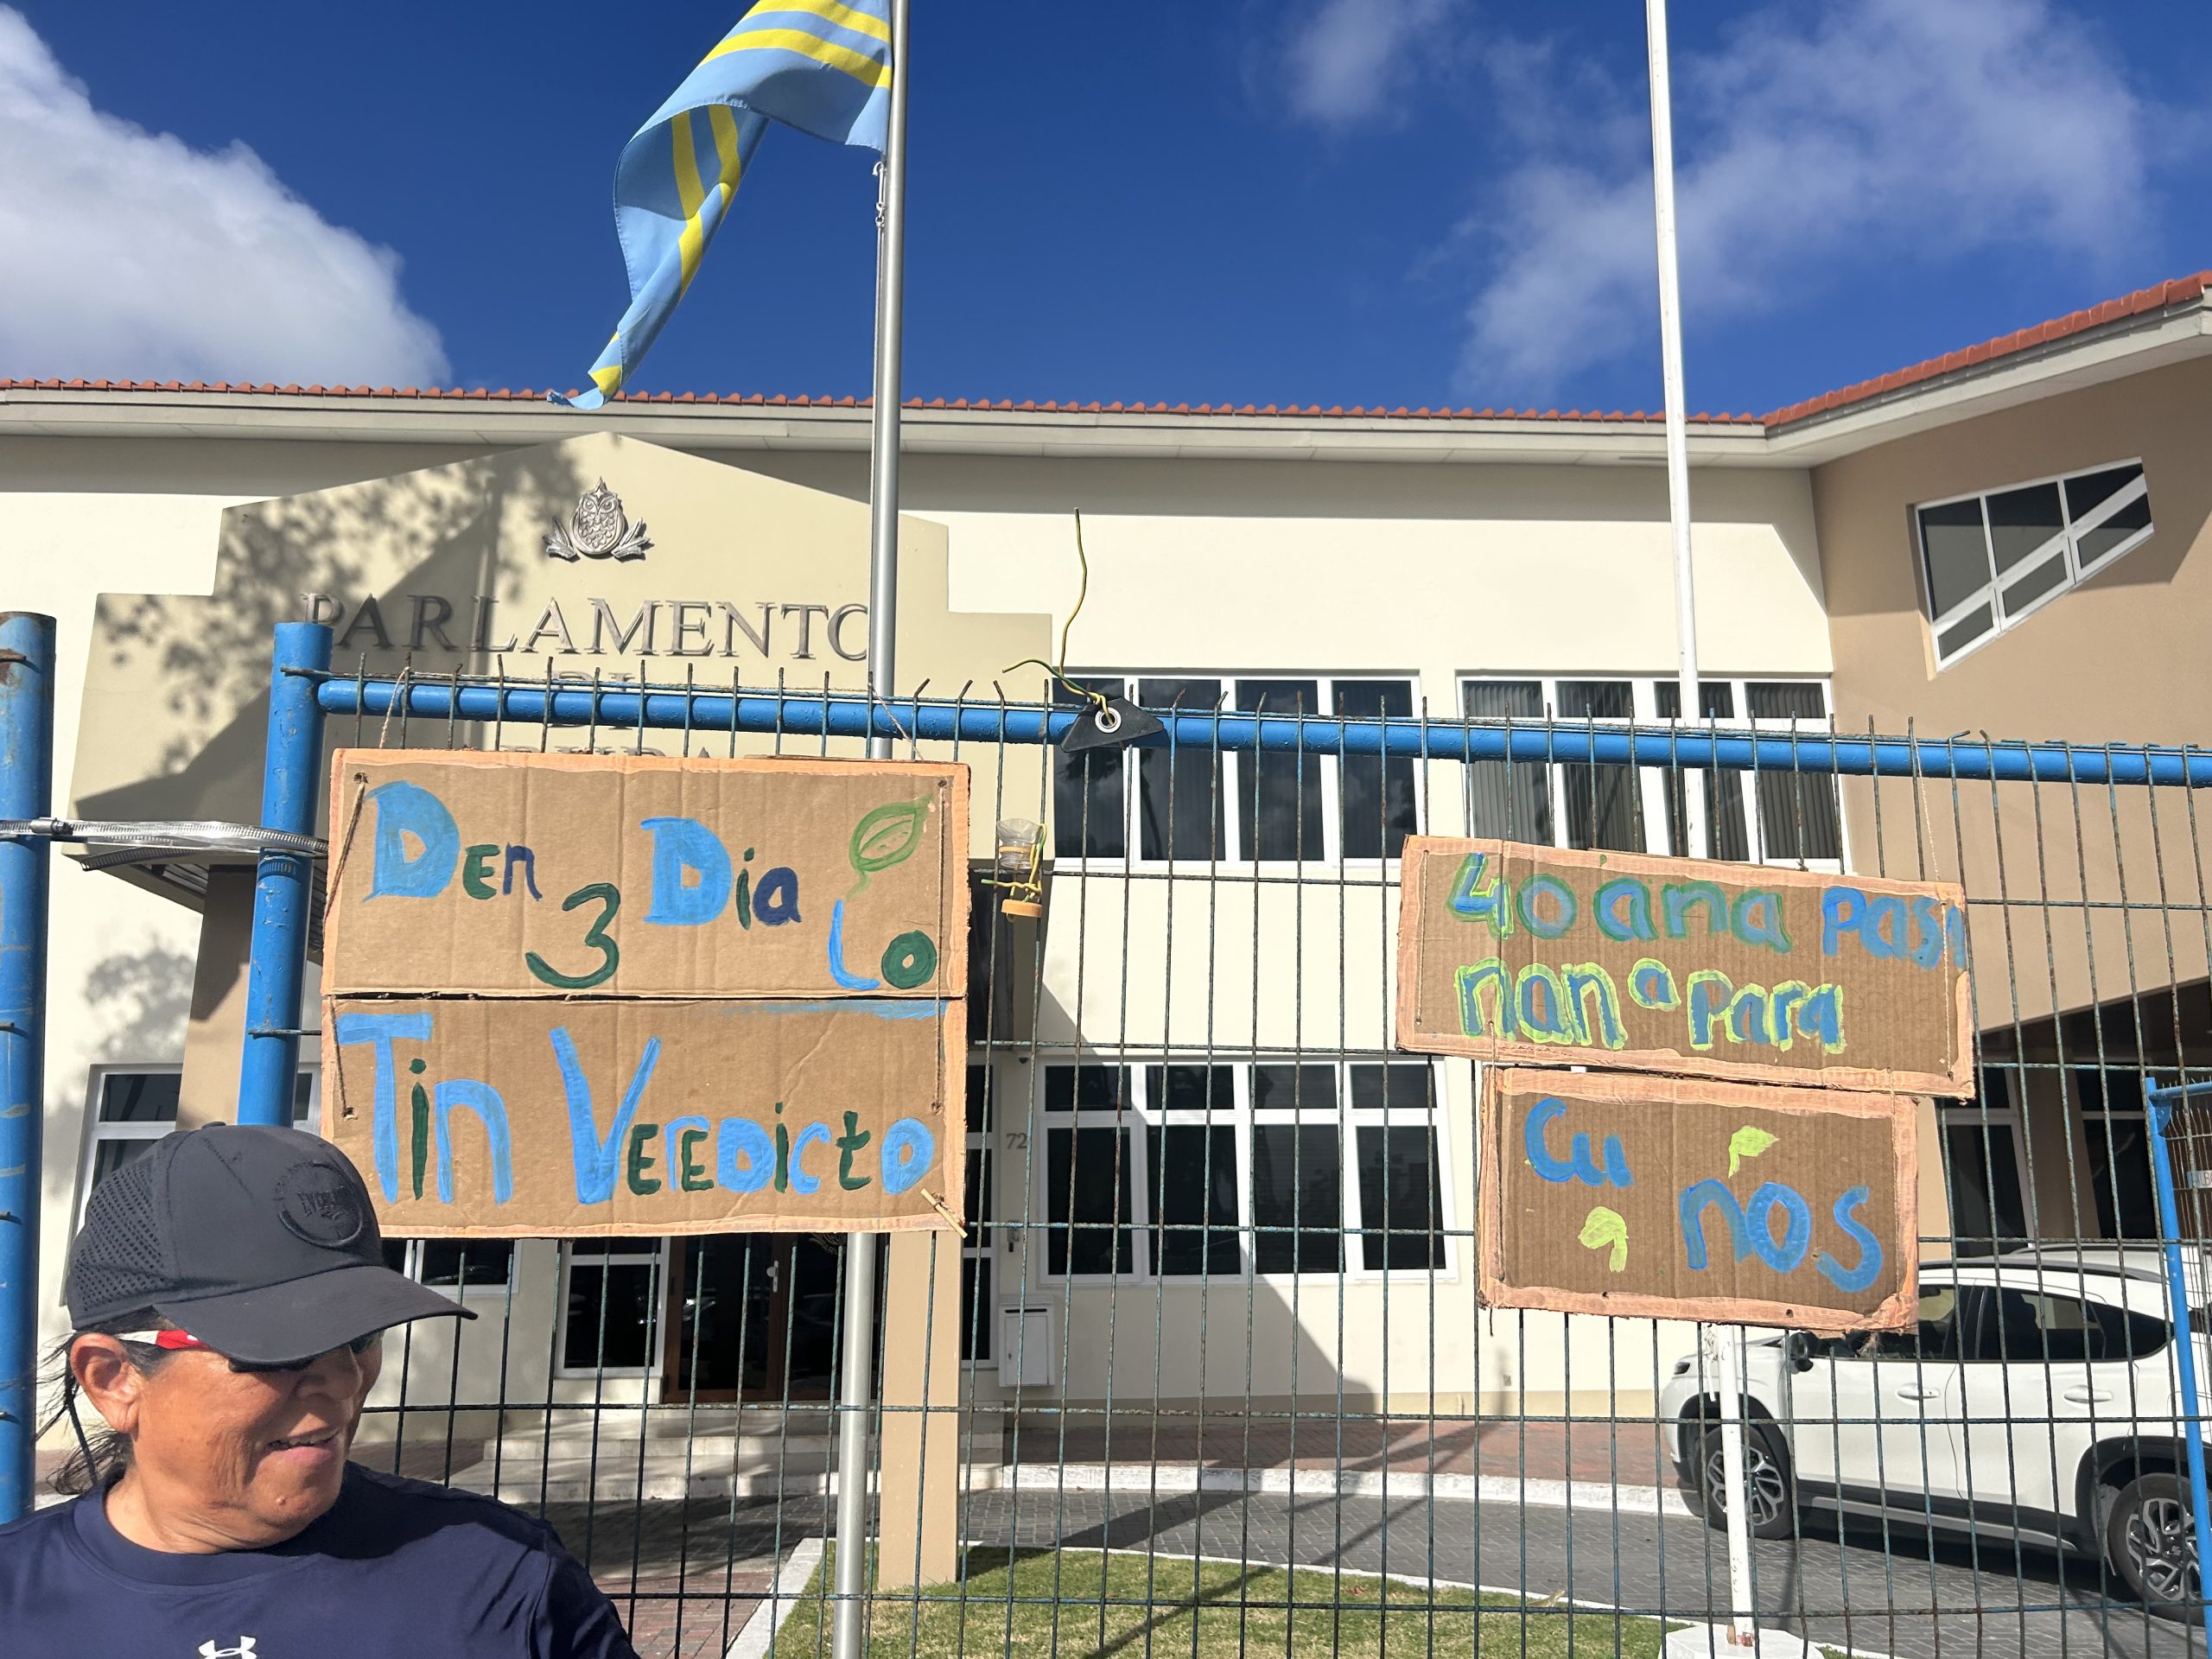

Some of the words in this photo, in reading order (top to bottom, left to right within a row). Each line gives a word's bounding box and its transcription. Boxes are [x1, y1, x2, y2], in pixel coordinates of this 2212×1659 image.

[301, 593, 868, 662] PARLAMENTO
[526, 882, 620, 990] 3
[641, 816, 801, 931] Dia
[828, 899, 938, 990] Lo
[335, 1013, 512, 1206] Tin
[1006, 1133, 1029, 1149] 72
[1524, 1098, 1634, 1187] Cu
